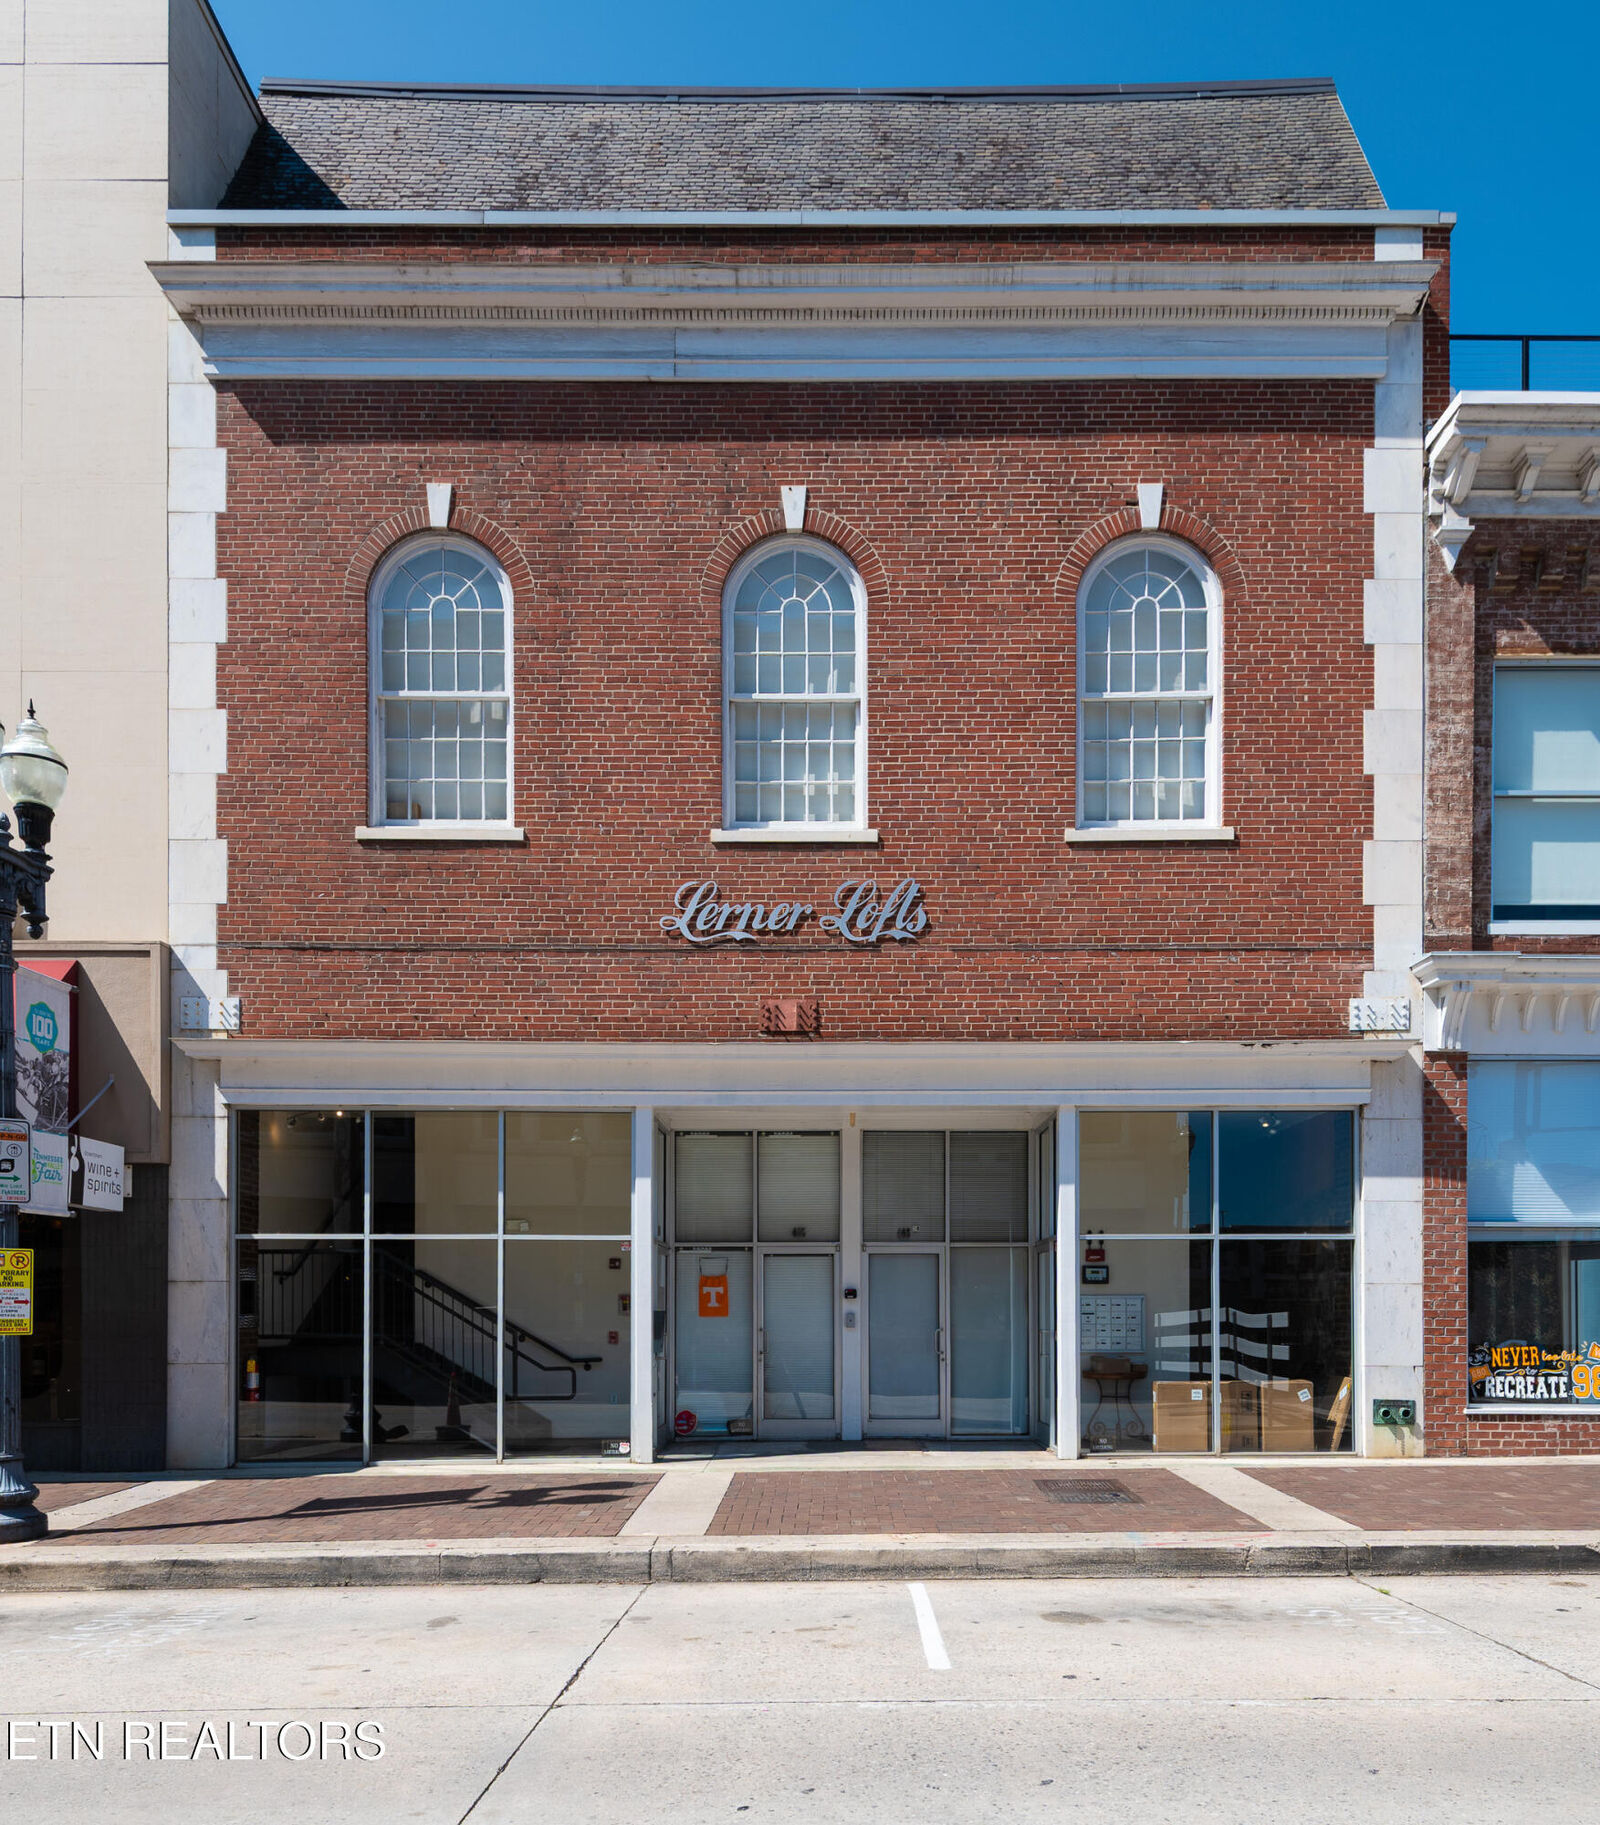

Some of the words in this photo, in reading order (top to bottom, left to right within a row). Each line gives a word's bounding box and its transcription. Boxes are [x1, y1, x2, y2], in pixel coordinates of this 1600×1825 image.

[659, 880, 813, 942] Lerner
[819, 877, 927, 942] Lofts
[32, 1013, 53, 1039] 100
[32, 1161, 63, 1184] Fair
[87, 1161, 112, 1177] wine
[87, 1178, 122, 1195] spirits
[702, 1286, 724, 1308] T
[1491, 1345, 1540, 1368] NEVER
[1541, 1349, 1560, 1361] too
[1561, 1349, 1584, 1362] late
[1525, 1366, 1538, 1376] to
[1485, 1375, 1568, 1399] RECREATE
